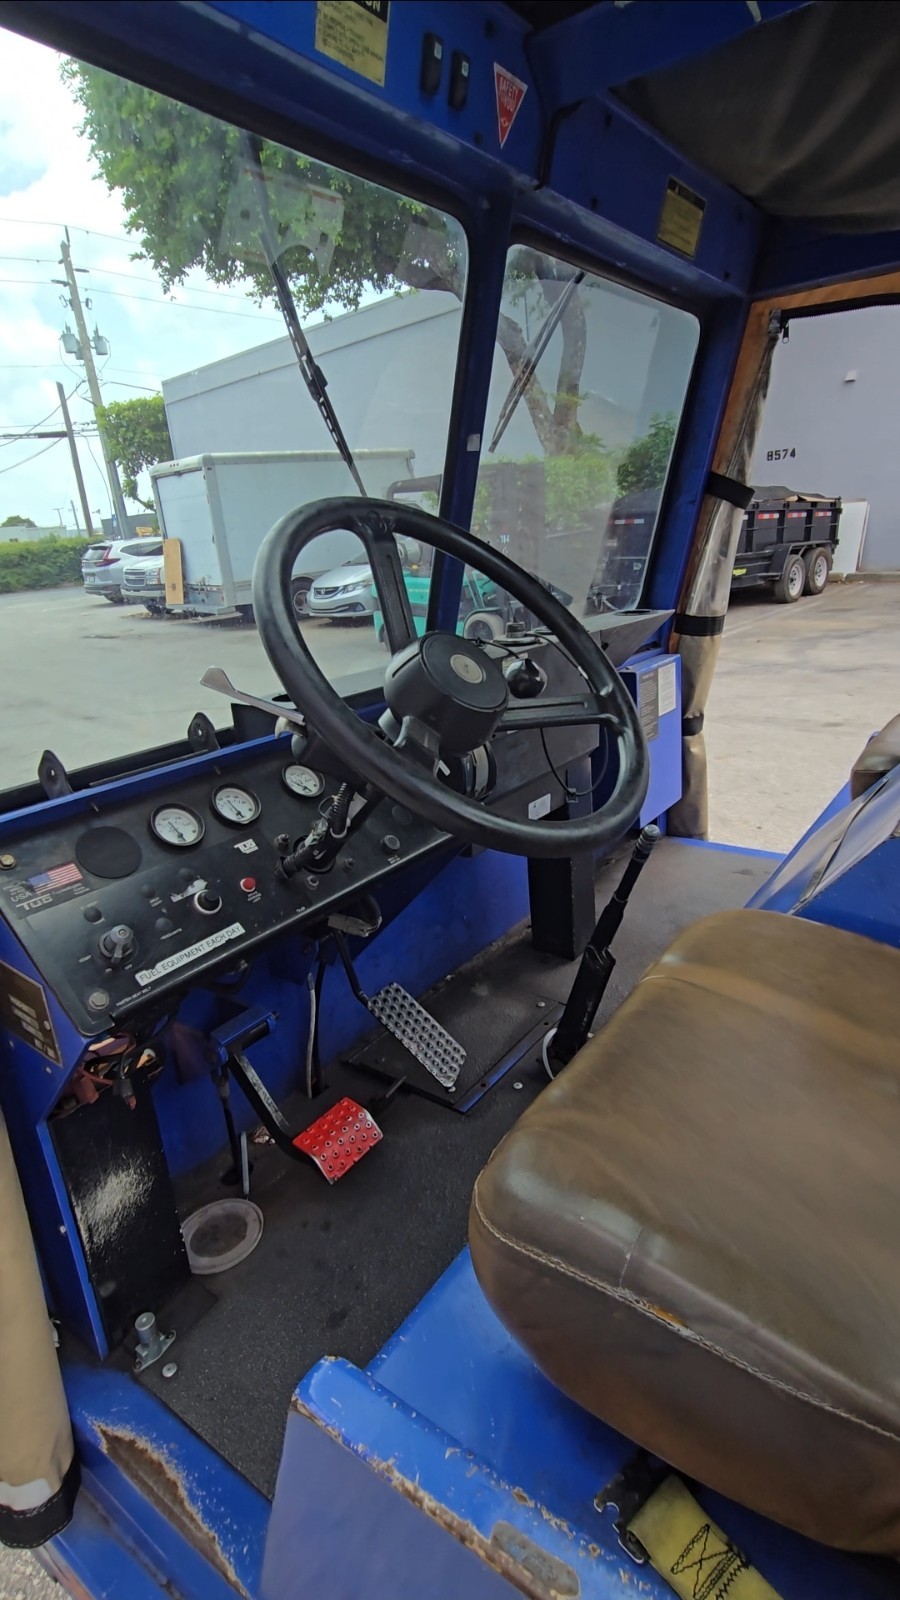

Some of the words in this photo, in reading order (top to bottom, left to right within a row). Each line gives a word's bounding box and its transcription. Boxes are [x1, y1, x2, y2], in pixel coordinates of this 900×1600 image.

[767, 448, 796, 461] 8574
[10, 892, 33, 903] USA
[139, 967, 162, 982] FUEL
[161, 945, 206, 971] EQUIPMENT
[205, 935, 227, 948] EACH
[227, 925, 241, 939] DAY
